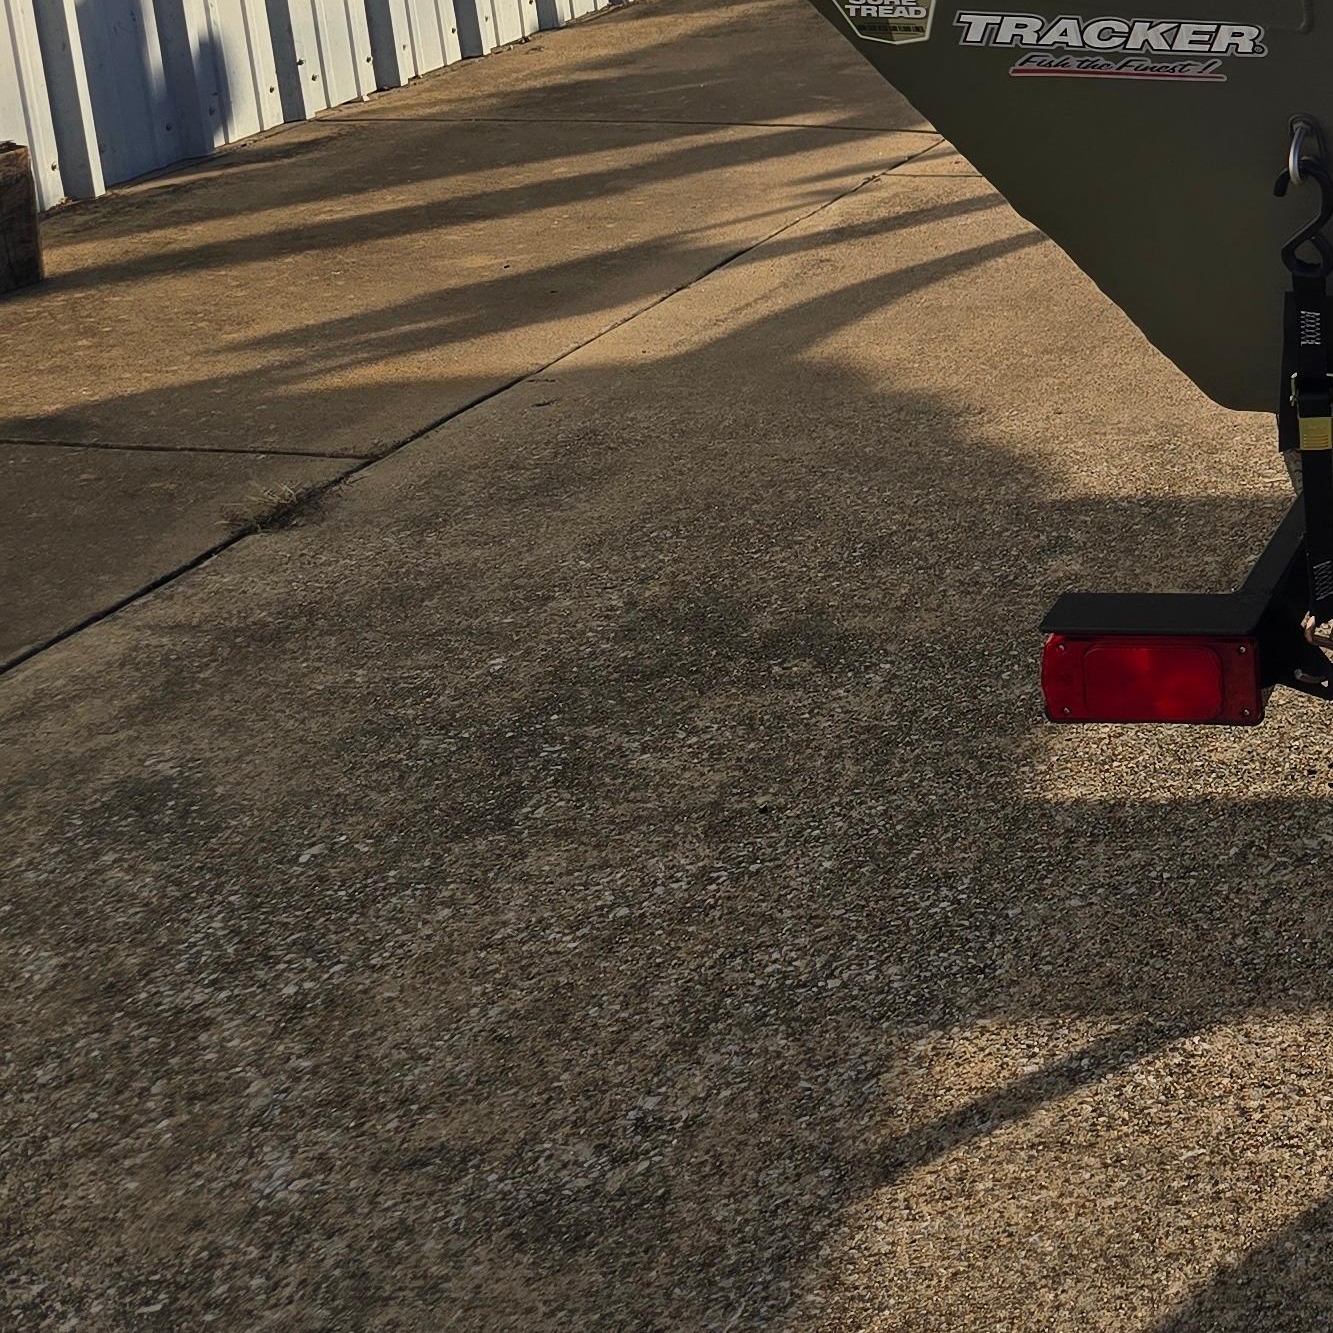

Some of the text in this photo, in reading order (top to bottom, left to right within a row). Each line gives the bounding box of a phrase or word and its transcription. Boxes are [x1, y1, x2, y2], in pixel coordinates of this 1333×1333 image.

[845, 4, 927, 18] TREAD
[958, 12, 1259, 54] TRACKER
[1018, 54, 1071, 68] Fish
[1074, 55, 1113, 70] the
